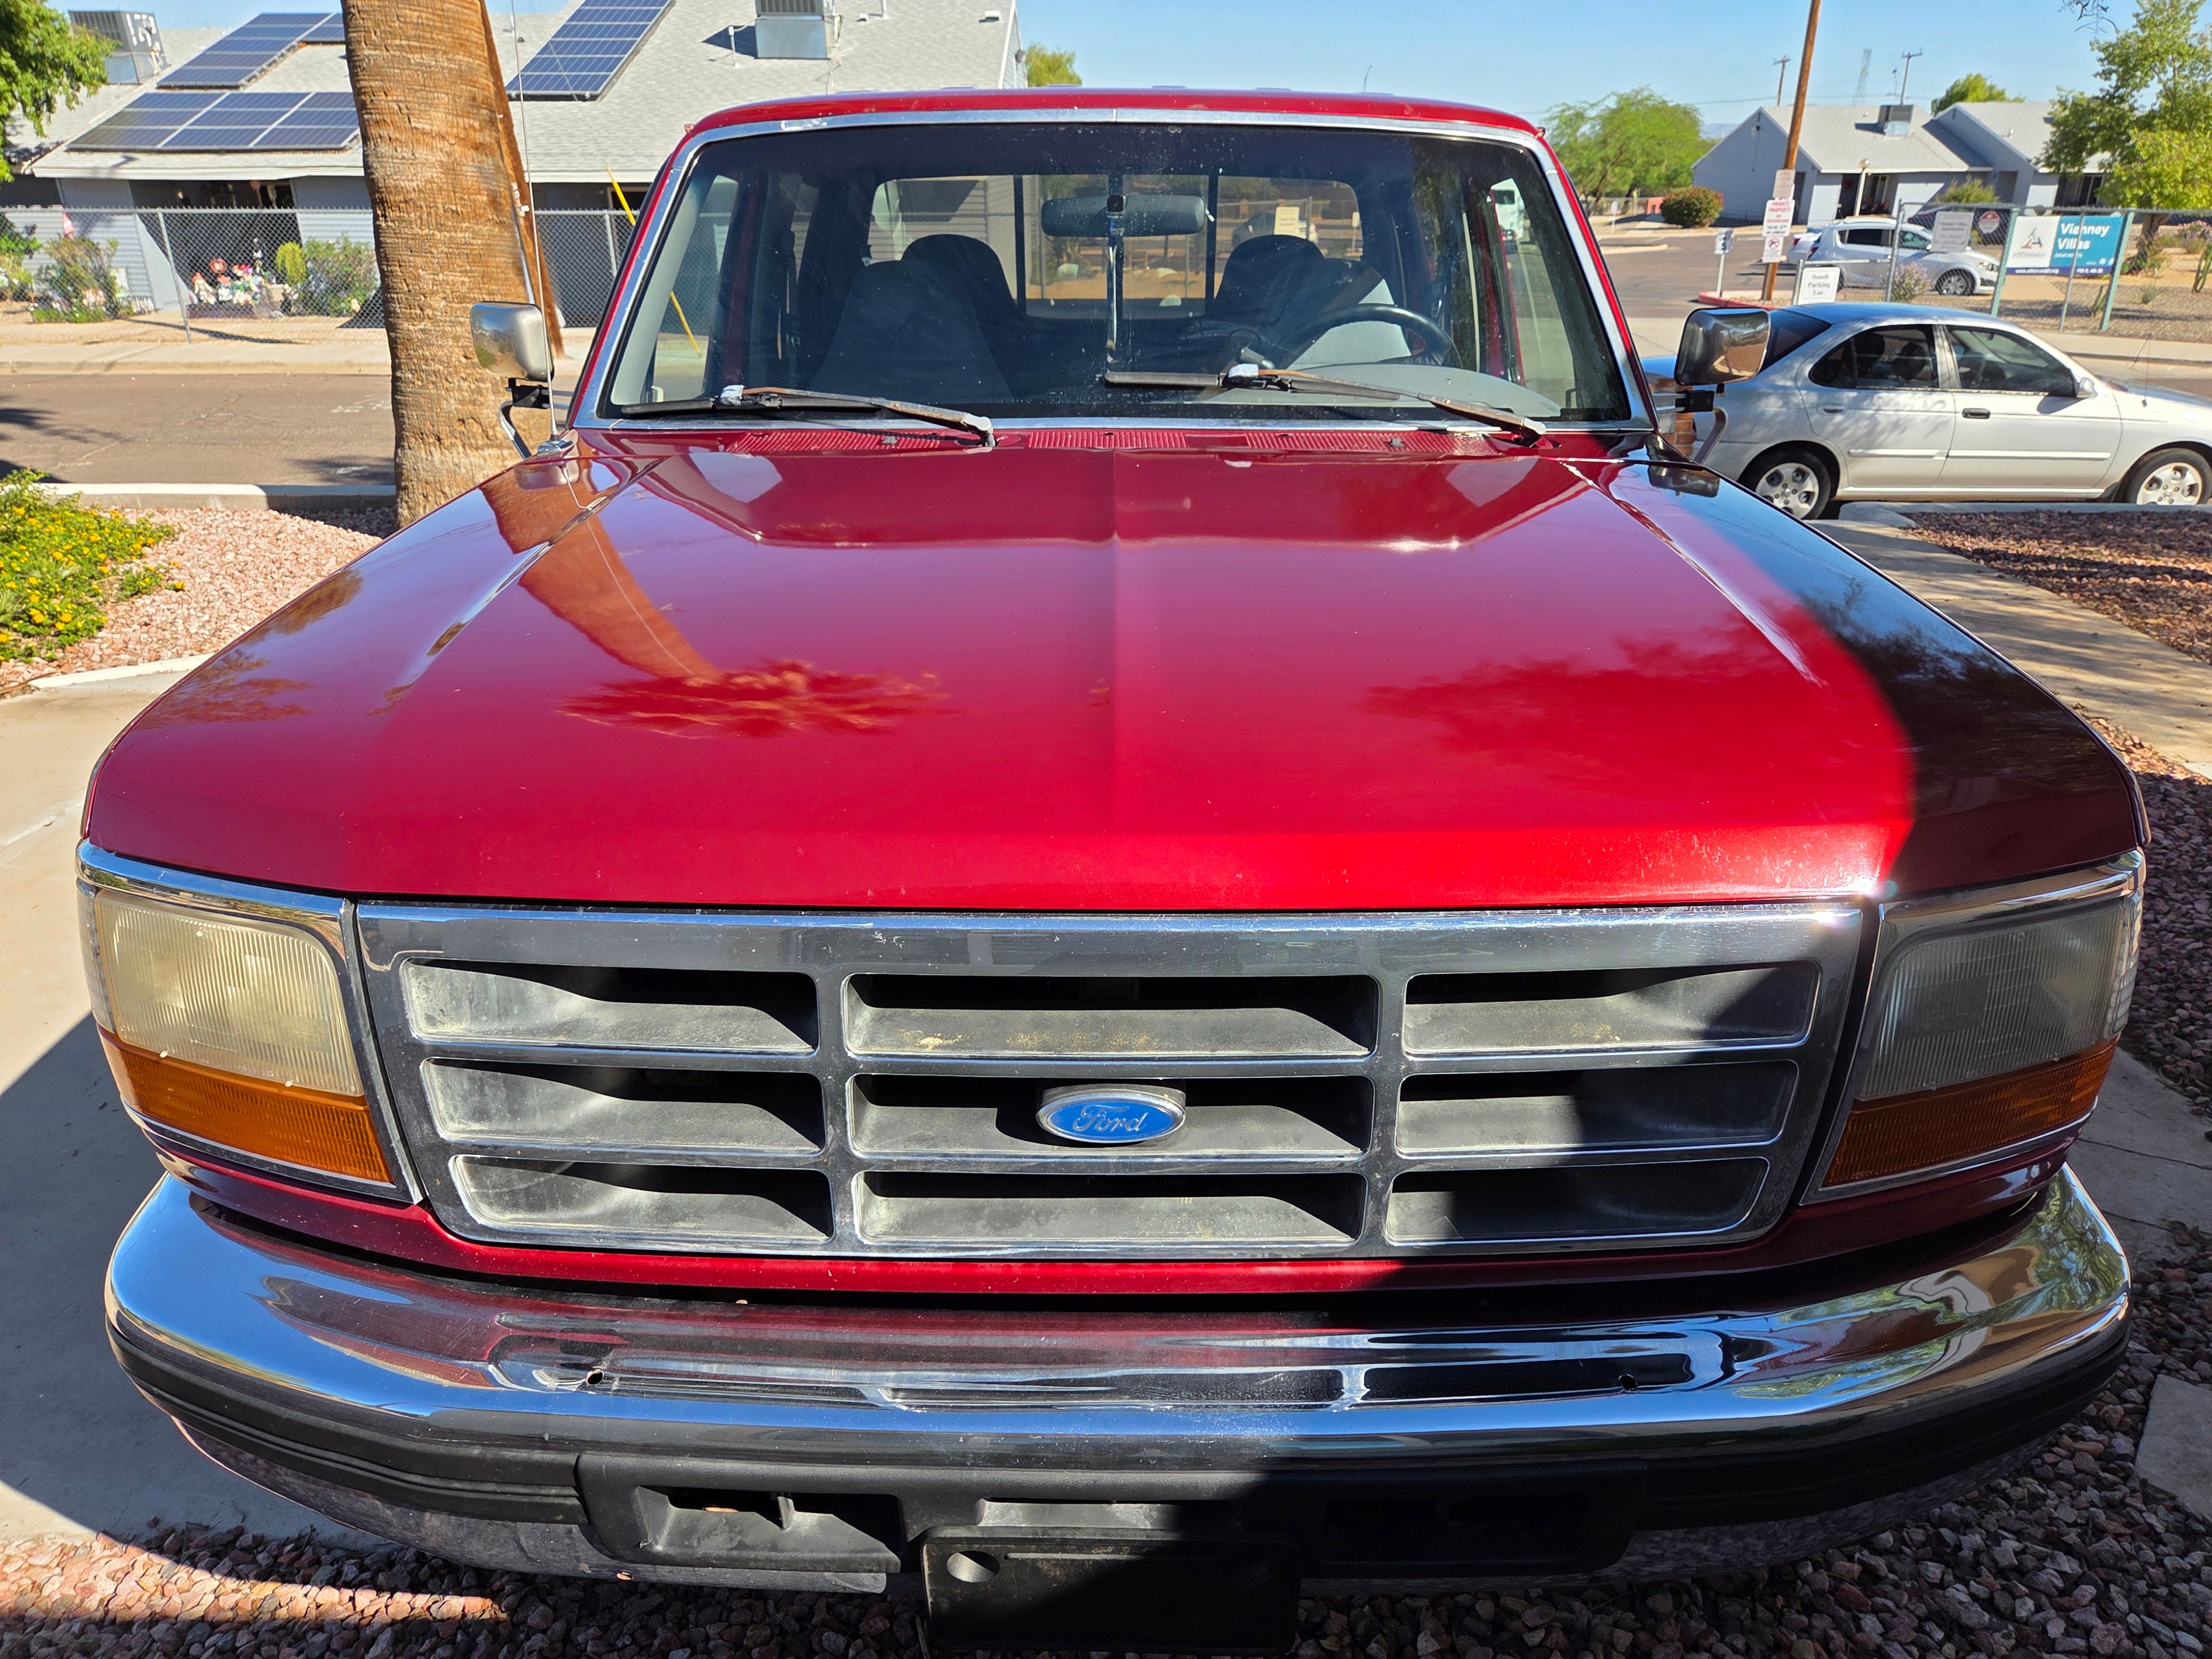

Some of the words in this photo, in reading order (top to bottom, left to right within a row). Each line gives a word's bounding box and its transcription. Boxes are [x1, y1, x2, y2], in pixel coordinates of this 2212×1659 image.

[2060, 223, 2110, 237] Vianney
[2057, 238, 2091, 250] Villas
[1072, 1104, 1149, 1133] Ford
